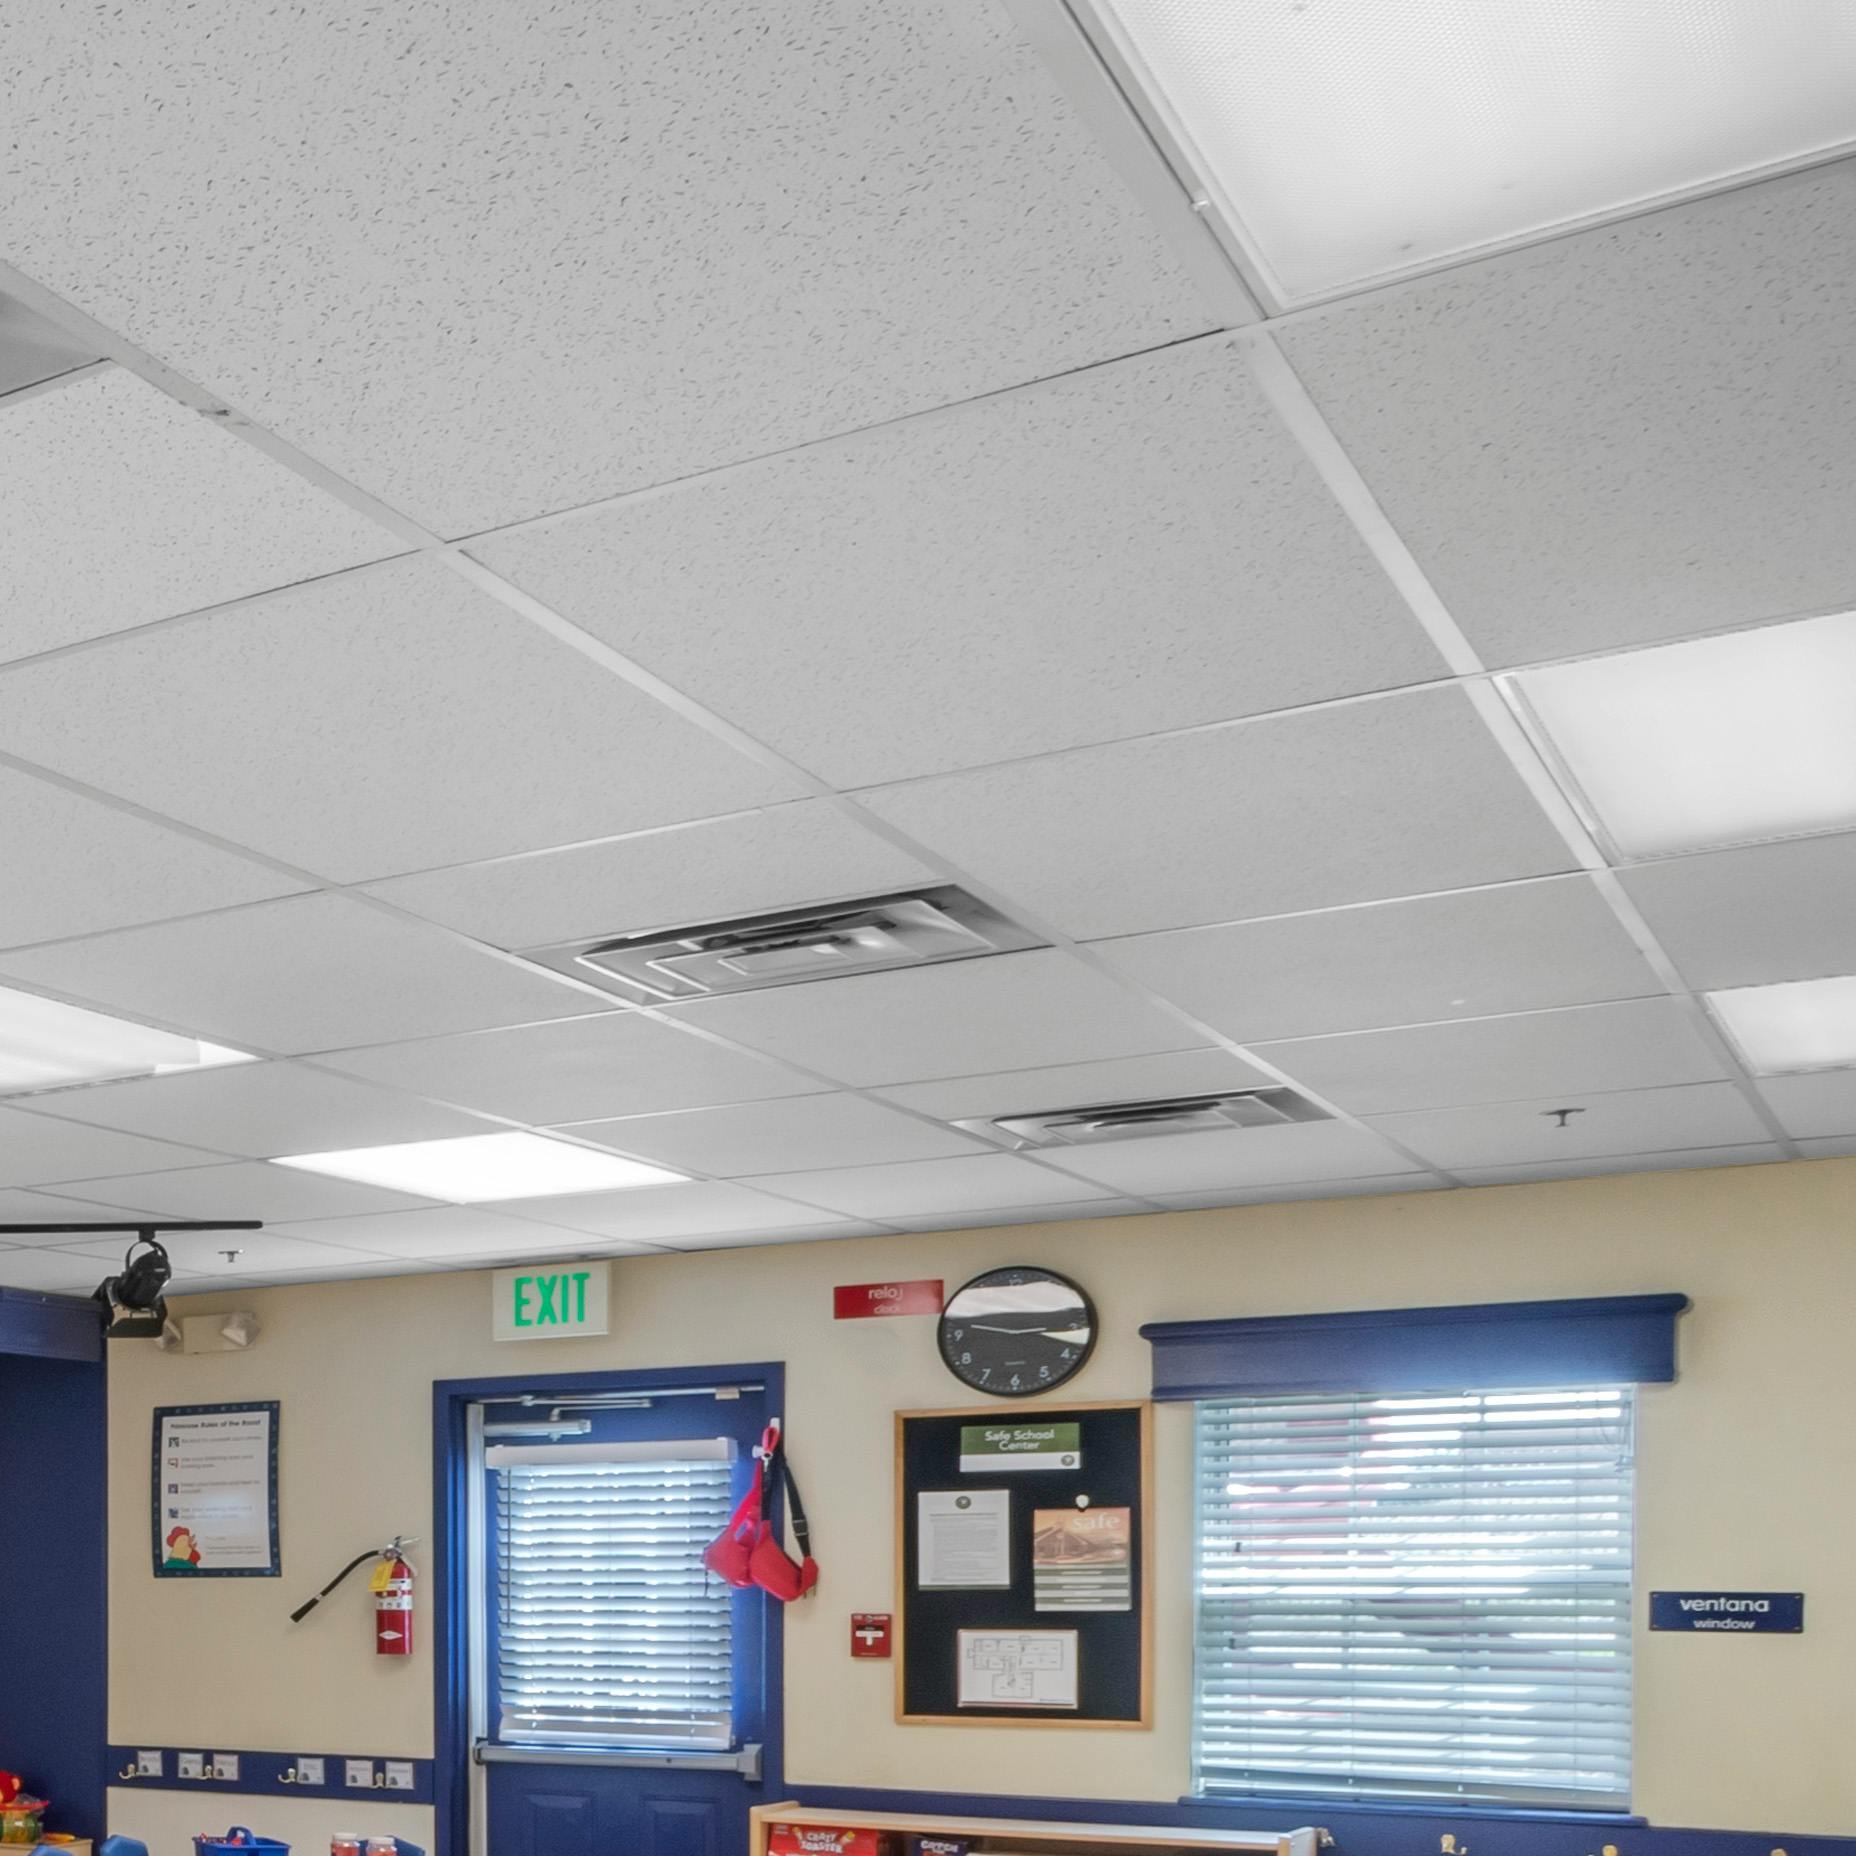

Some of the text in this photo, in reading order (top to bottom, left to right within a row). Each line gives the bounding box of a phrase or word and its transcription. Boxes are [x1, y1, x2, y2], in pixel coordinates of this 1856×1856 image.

[868, 1285, 904, 1300] reloj
[514, 1272, 590, 1327] EXIT
[954, 1330, 964, 1341] 9
[961, 1353, 972, 1364] 8
[1061, 1348, 1071, 1359] 4
[982, 1369, 991, 1380] 7
[1039, 1366, 1049, 1378] 5
[1010, 1375, 1020, 1386] 6
[985, 1428, 1056, 1442] Safe School
[999, 1440, 1040, 1451] Center
[1072, 1512, 1120, 1530] safe
[1680, 1597, 1770, 1612] ventana
[1693, 1618, 1756, 1630] window
[806, 1831, 837, 1844] CRAZY
[800, 1840, 843, 1854] TOASTER
